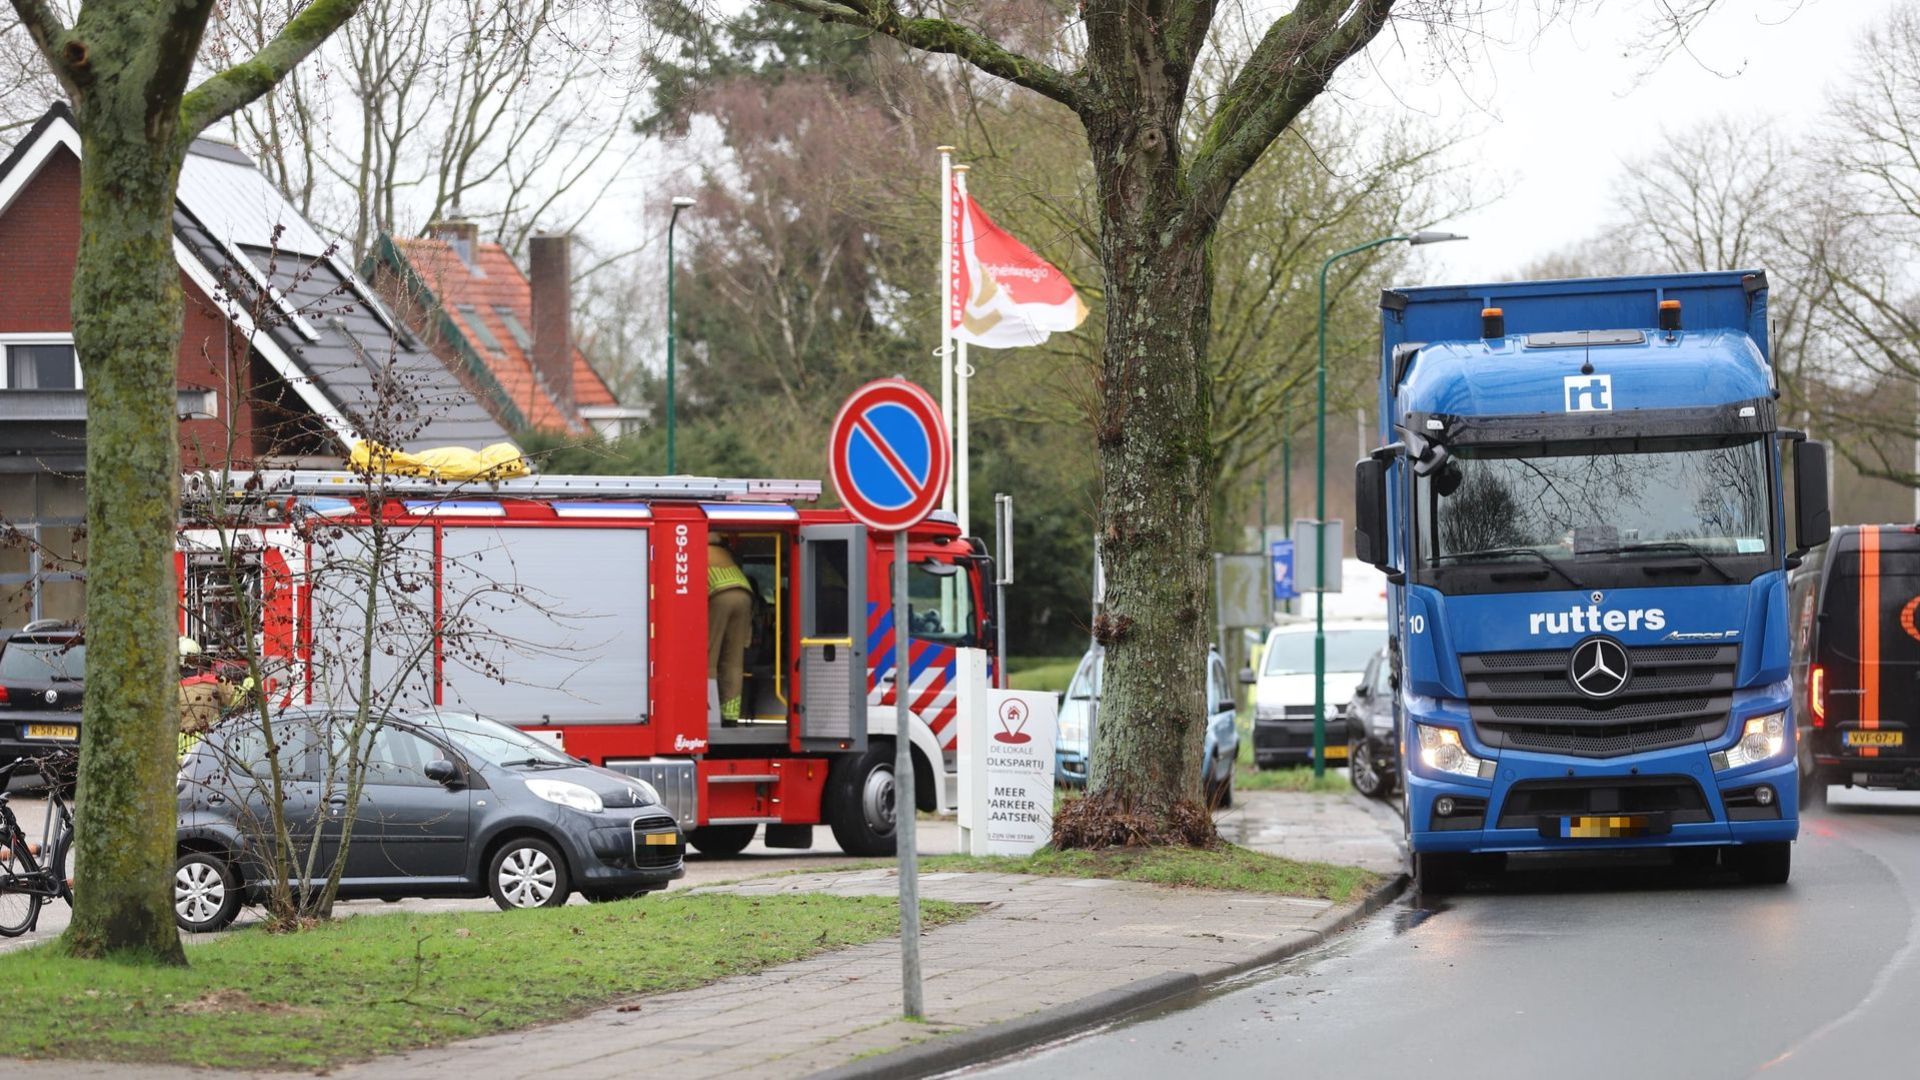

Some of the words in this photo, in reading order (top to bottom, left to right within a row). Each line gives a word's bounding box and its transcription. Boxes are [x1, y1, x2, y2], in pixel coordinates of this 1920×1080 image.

[1569, 379, 1609, 410] rt
[675, 524, 688, 595] 09-3231
[1409, 614, 1425, 634] 10
[1529, 604, 1666, 635] rutters
[986, 757, 1044, 770] OLKSPARTIJ
[994, 786, 1026, 797] MEER
[987, 798, 1035, 810] ARKEER
[987, 811, 1041, 823] AATSEN!
